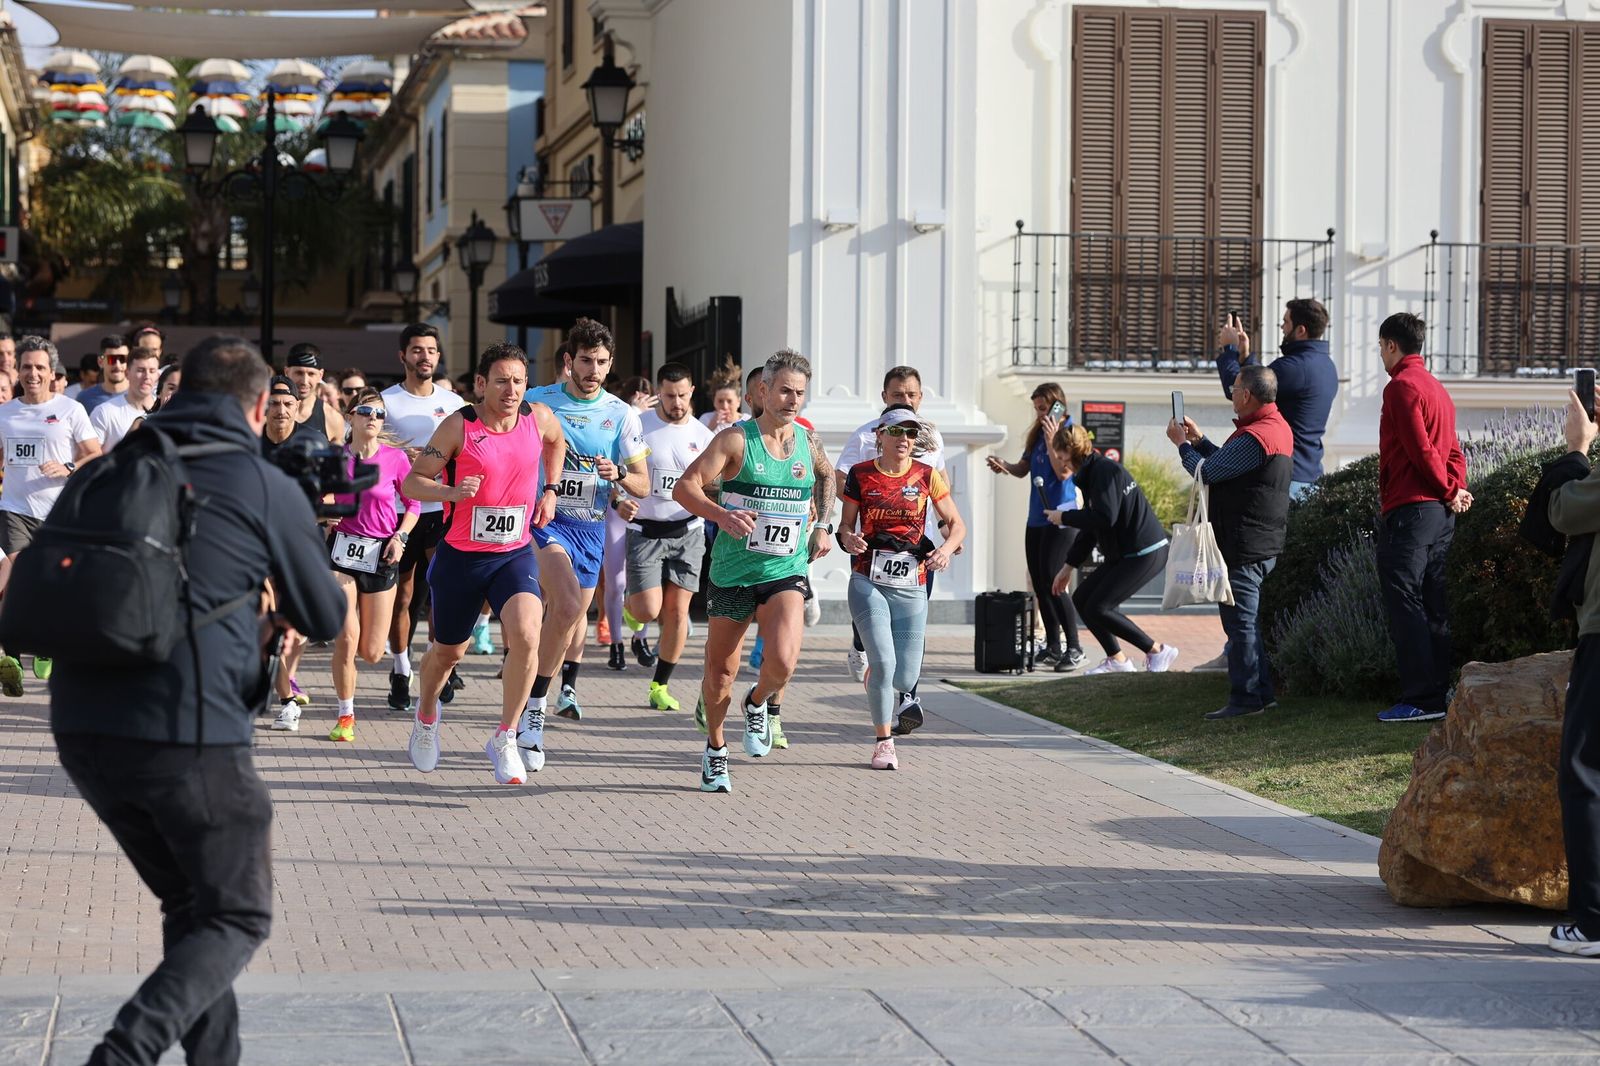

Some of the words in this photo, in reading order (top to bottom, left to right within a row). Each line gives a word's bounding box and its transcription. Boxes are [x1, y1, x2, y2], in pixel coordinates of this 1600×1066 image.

[16, 443, 36, 457] 501
[560, 479, 584, 497] 161
[753, 486, 802, 499] ATLETISMO
[742, 497, 806, 513] TORREMOLINOS
[867, 508, 885, 520] XII
[485, 515, 515, 532] 240
[765, 525, 790, 543] 179
[347, 543, 365, 560] 84
[883, 560, 910, 577] 425
